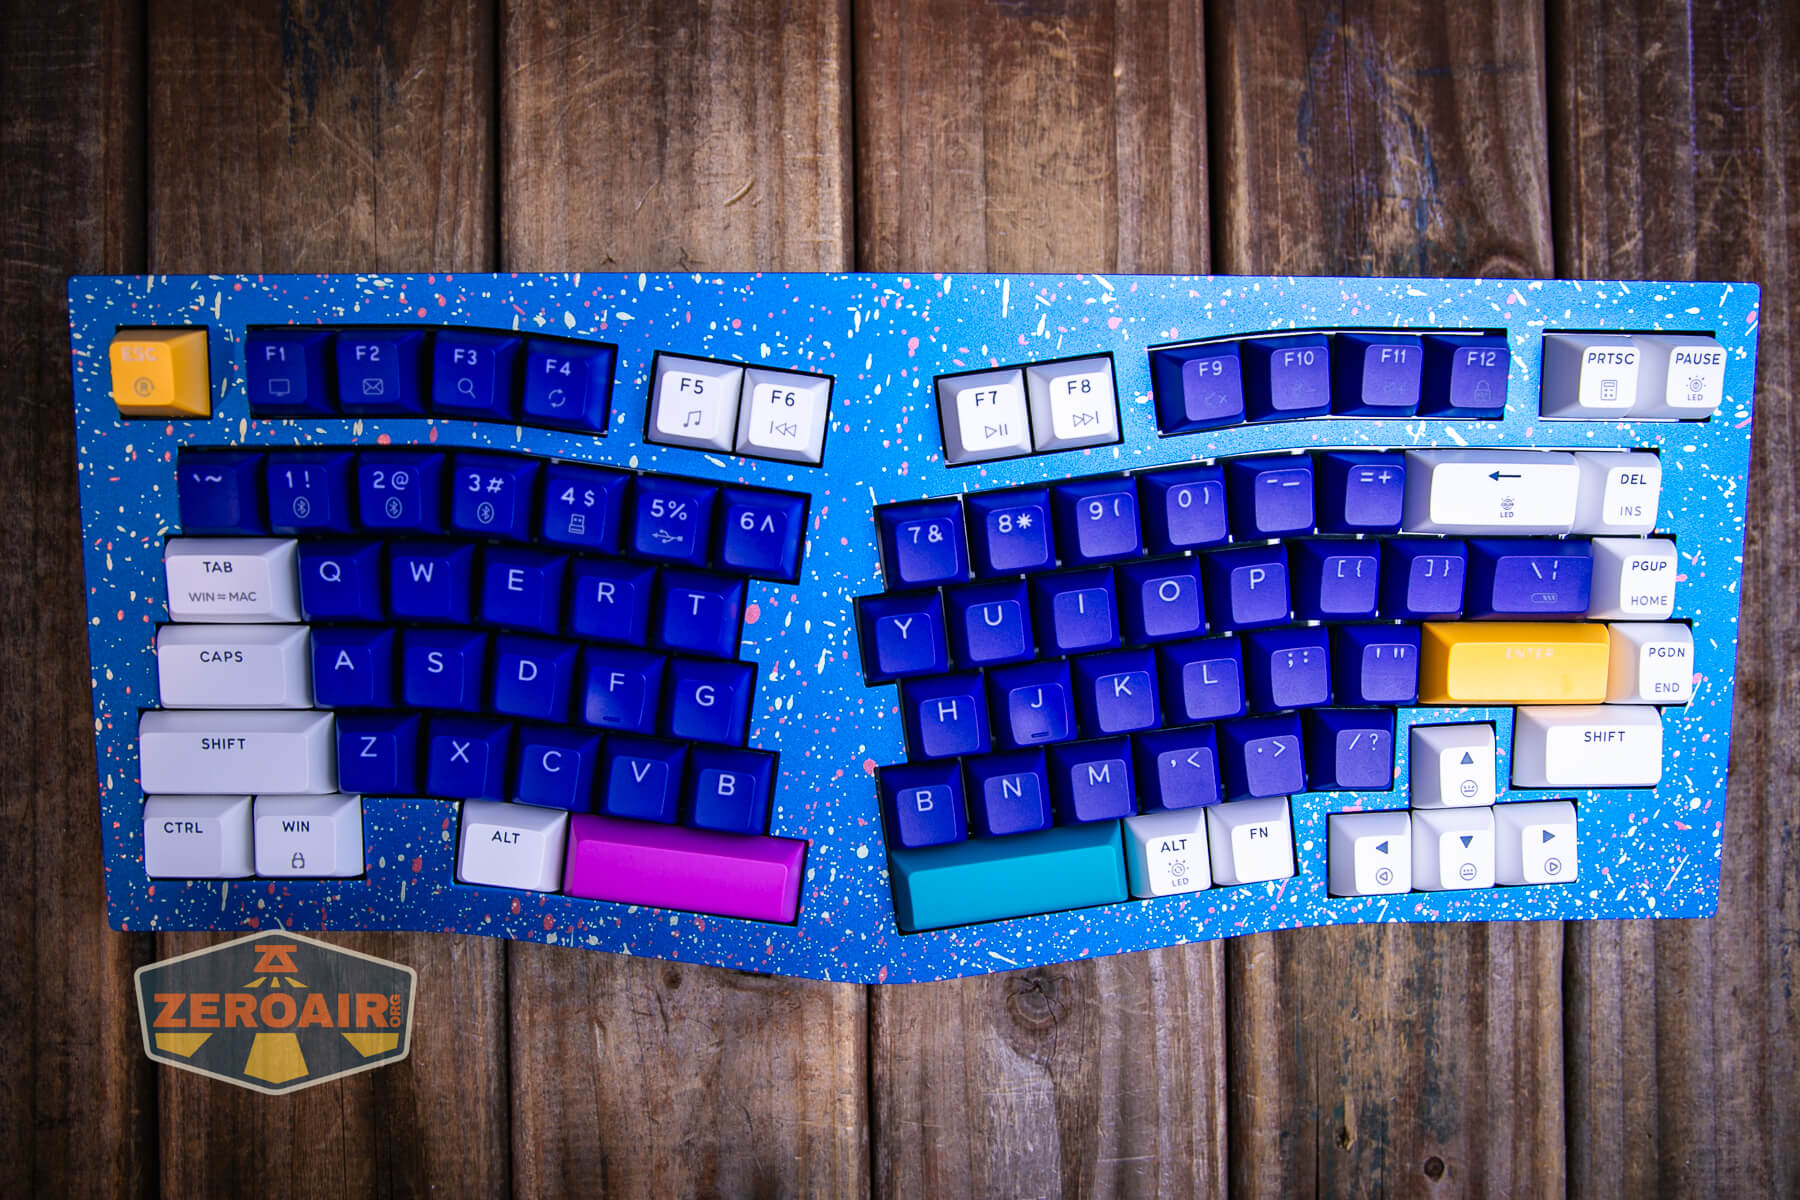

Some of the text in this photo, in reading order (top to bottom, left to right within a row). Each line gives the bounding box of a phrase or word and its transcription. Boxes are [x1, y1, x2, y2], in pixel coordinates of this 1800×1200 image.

[121, 346, 158, 362] ESC
[266, 346, 286, 362] F1
[356, 346, 380, 362] F2
[454, 348, 478, 366] F3
[1284, 352, 1314, 367] F10
[1381, 348, 1407, 364] F11
[1466, 352, 1497, 367] F12
[1587, 352, 1635, 366] PRTSC
[1674, 352, 1722, 366] PAUSE
[546, 358, 571, 376] F4
[1199, 360, 1223, 377] F9
[680, 377, 705, 395] F5
[1068, 380, 1092, 395] F8
[772, 390, 796, 407] F6
[975, 390, 998, 407] F7
[1687, 394, 1703, 402] LED
[1620, 474, 1647, 485] DEL
[1500, 511, 1514, 519] LED
[1620, 506, 1642, 517] INS
[202, 562, 233, 574] TAB
[320, 560, 342, 583] Q
[410, 562, 434, 583] W
[1632, 560, 1668, 572] PGUP
[508, 569, 524, 591] E
[1250, 568, 1266, 590] P
[597, 582, 616, 605] R
[1158, 580, 1181, 602] O
[688, 594, 706, 616] T
[1078, 593, 1085, 614] I
[1630, 594, 1668, 606] HOME
[984, 604, 1003, 626] U
[894, 618, 913, 640] Y
[199, 650, 244, 663] CAPS
[334, 650, 355, 671] A
[1648, 647, 1686, 658] PGDN
[427, 652, 444, 674] S
[518, 660, 538, 682] D
[610, 672, 625, 693] F
[1202, 664, 1219, 685] L
[1114, 676, 1133, 698] K
[1654, 682, 1680, 693] END
[695, 686, 716, 707] G
[1030, 688, 1043, 709] J
[938, 700, 958, 723] H
[202, 738, 246, 751] SHIFT
[1584, 730, 1626, 743] SHIFT
[360, 736, 378, 757] Z
[450, 740, 471, 764] X
[542, 750, 561, 773] C
[632, 760, 651, 783] V
[1088, 764, 1111, 786] M
[718, 774, 736, 797] B
[1002, 777, 1023, 800] N
[916, 790, 934, 812] B
[163, 822, 204, 834] CTRL
[282, 820, 311, 833] WIN
[1250, 826, 1269, 839] FN
[492, 830, 521, 845] ALT
[1160, 838, 1188, 853] ALT
[1171, 876, 1190, 888] LED
